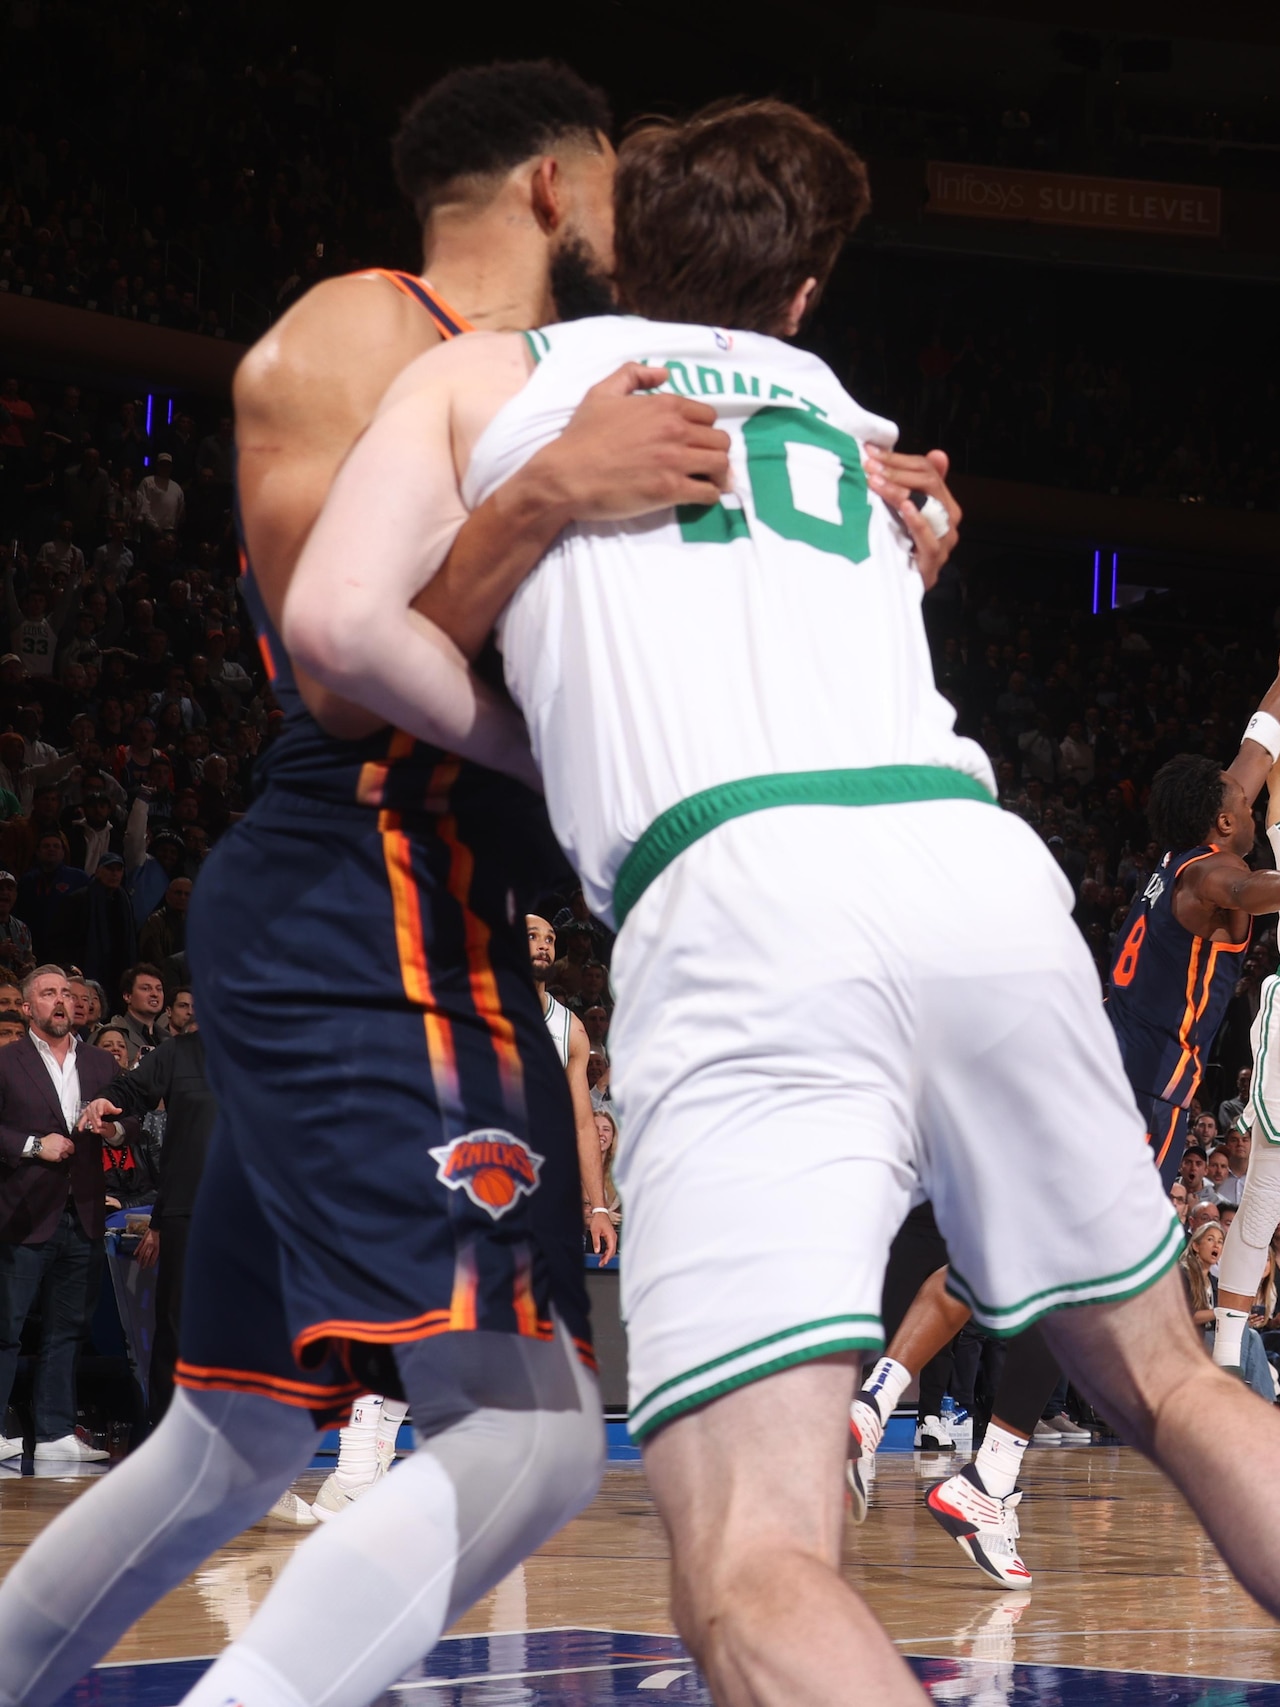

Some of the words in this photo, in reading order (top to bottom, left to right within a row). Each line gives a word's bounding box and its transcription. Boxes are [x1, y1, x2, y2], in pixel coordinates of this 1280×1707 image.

[936, 171, 1025, 211] Infosys
[1039, 187, 1118, 215] SUITE
[1128, 195, 1211, 224] LEVEL
[1113, 914, 1147, 987] 8
[444, 1141, 536, 1184] KNICKS
